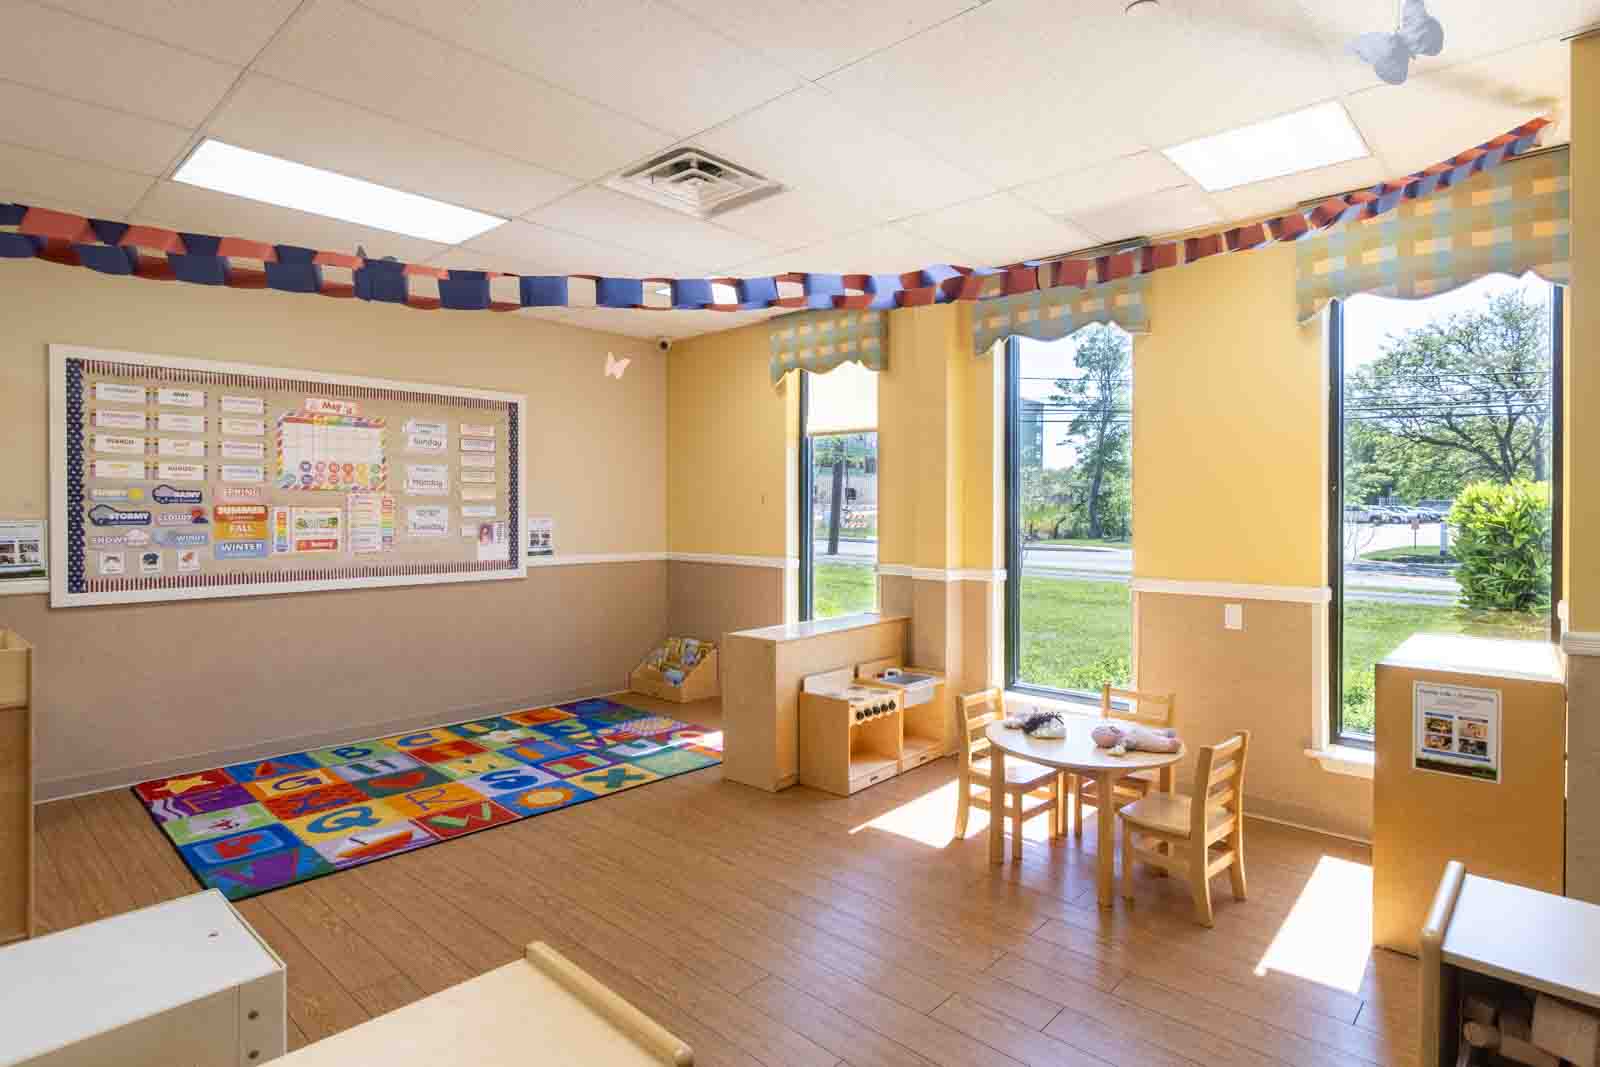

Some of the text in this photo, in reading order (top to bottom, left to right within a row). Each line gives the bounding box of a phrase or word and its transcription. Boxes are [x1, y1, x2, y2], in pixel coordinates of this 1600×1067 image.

[109, 511, 149, 520] STORMY
[479, 769, 539, 790] S
[306, 806, 383, 834] Q
[427, 800, 492, 828] W
